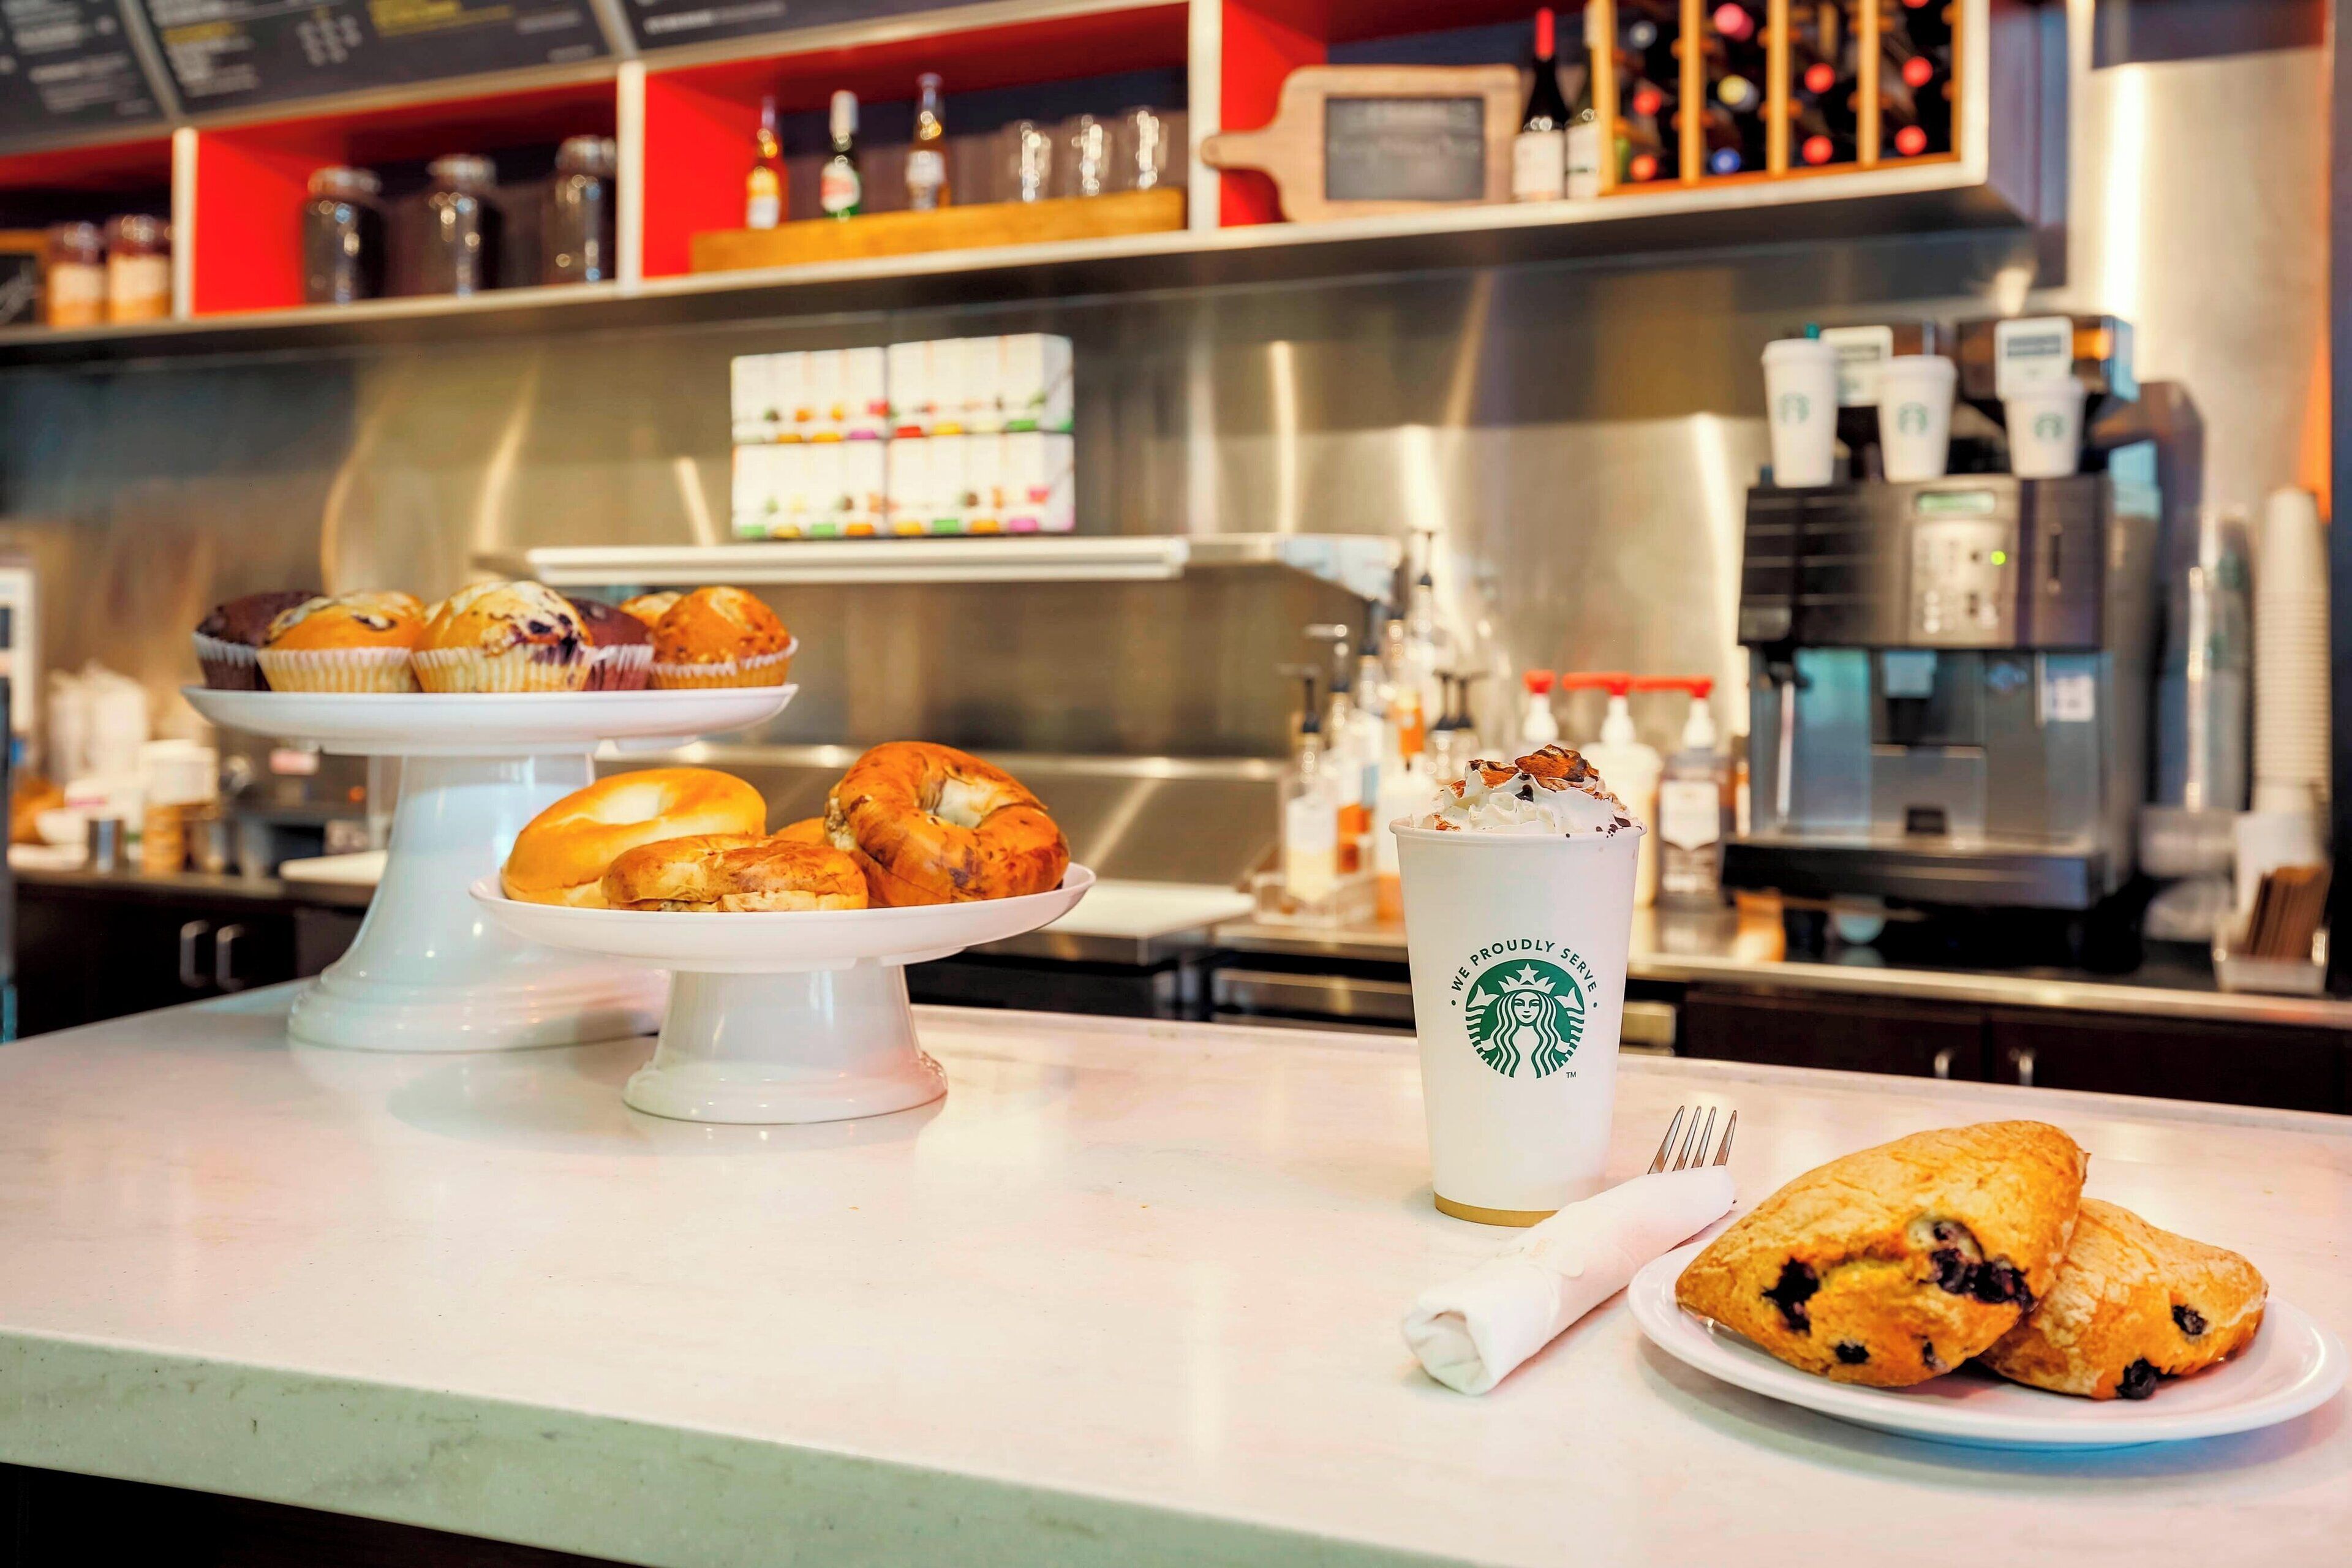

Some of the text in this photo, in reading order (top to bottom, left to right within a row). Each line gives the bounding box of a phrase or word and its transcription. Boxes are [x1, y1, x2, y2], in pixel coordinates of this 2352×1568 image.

[1451, 939, 1597, 992] WE PROUDLY SERVE
